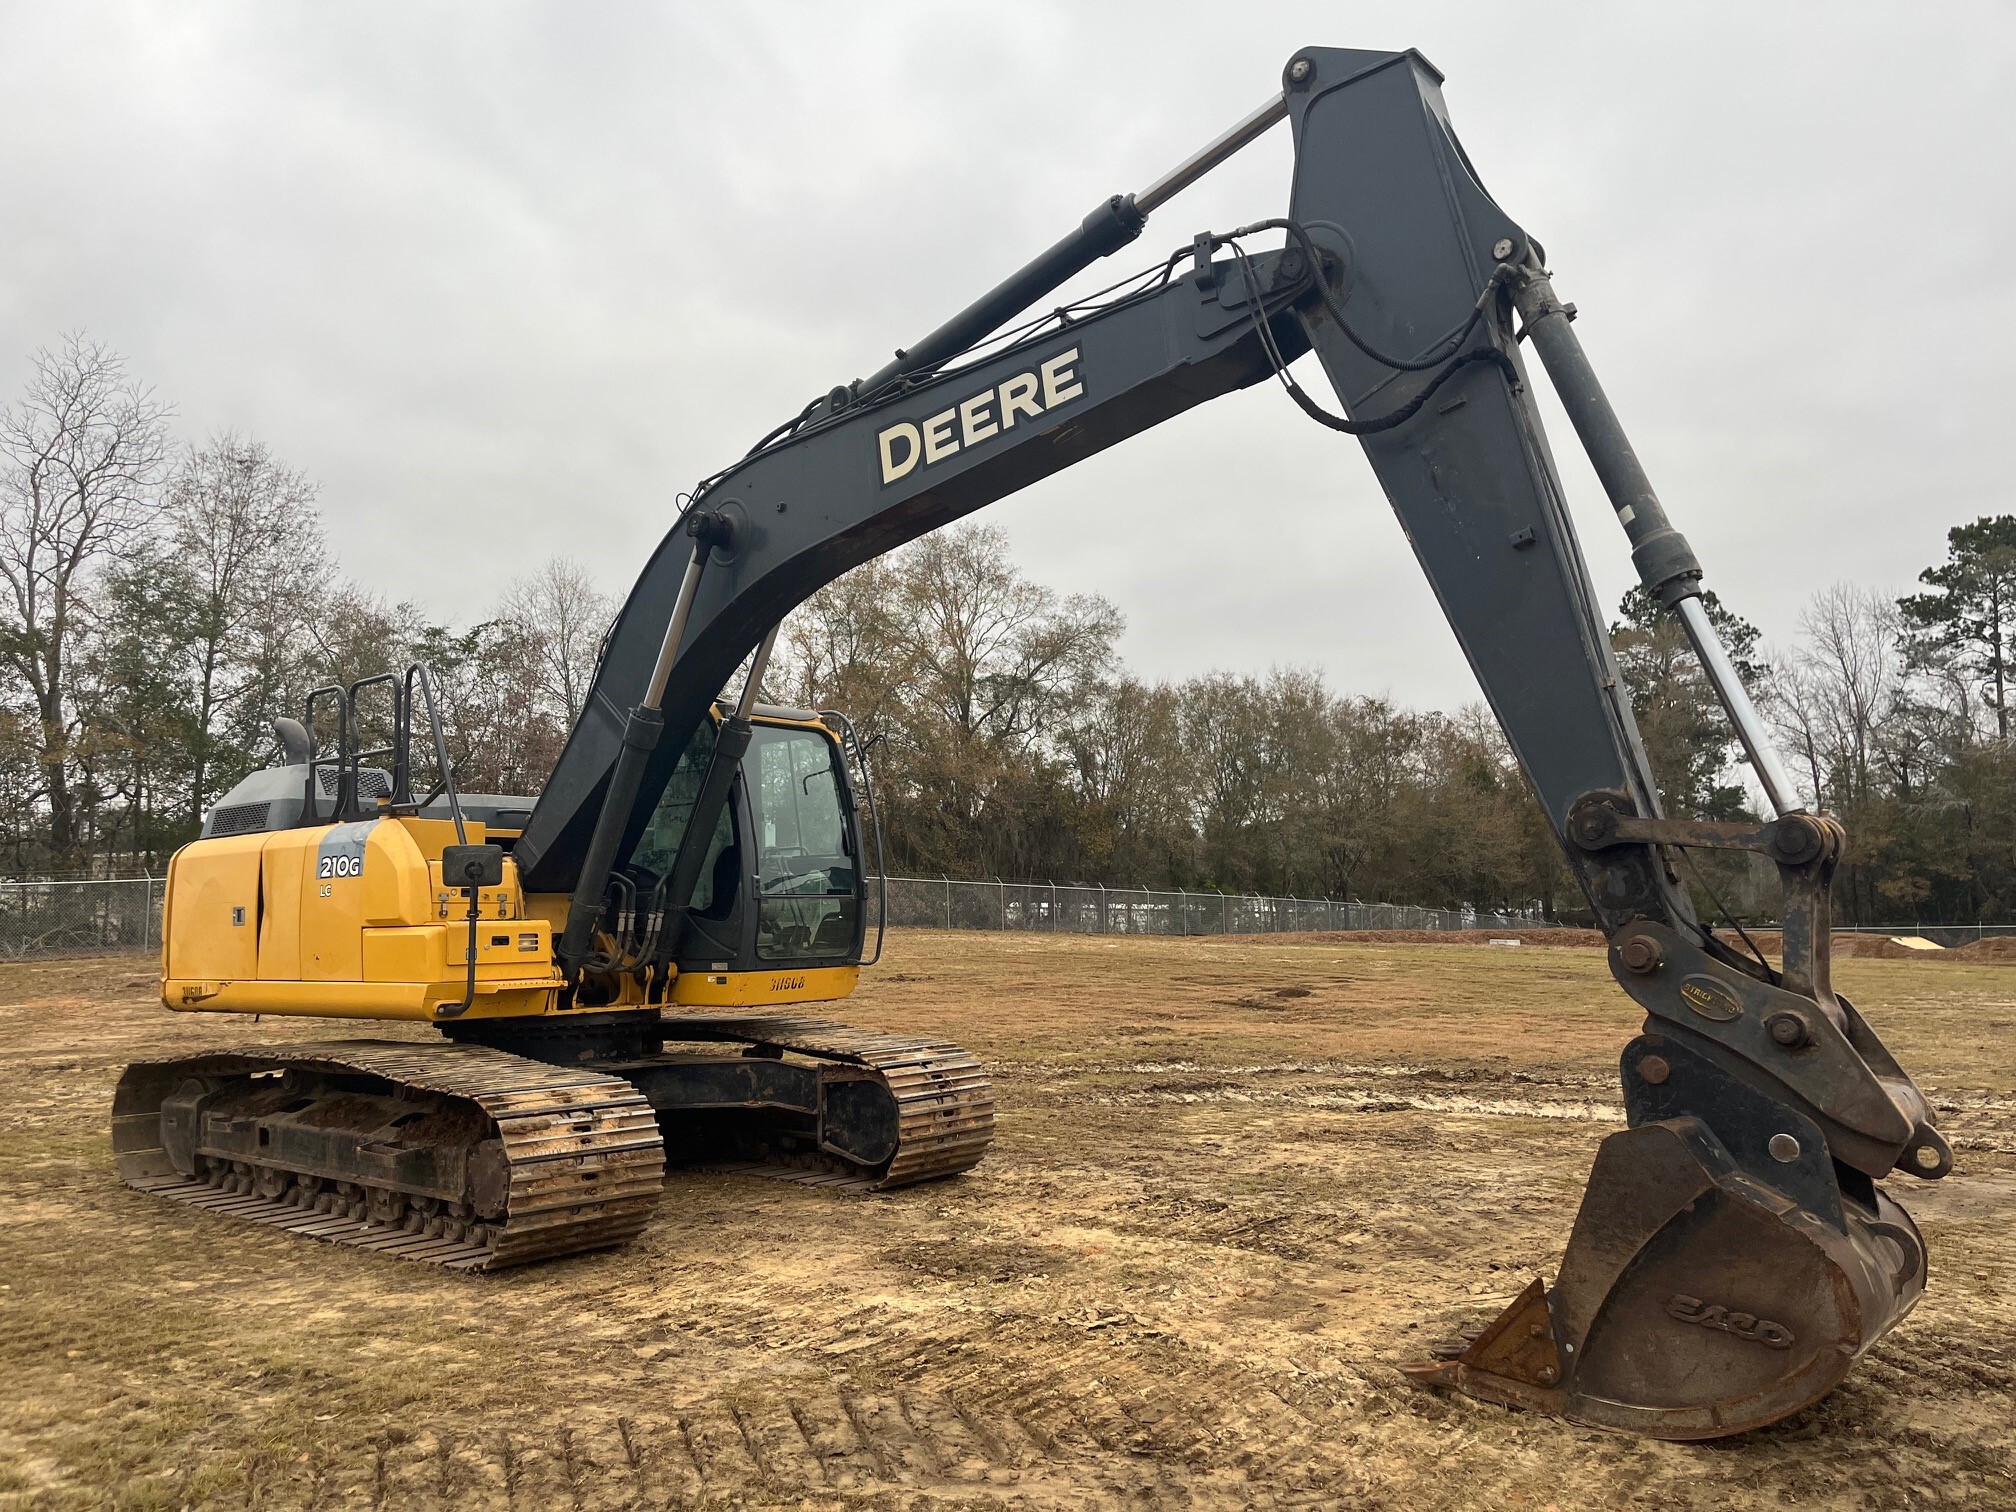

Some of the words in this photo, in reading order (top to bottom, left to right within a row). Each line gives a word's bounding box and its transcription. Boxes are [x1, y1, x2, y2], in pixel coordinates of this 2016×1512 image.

[879, 347, 1083, 484] DEERE
[320, 855, 360, 878] 210G
[320, 884, 332, 897] LC
